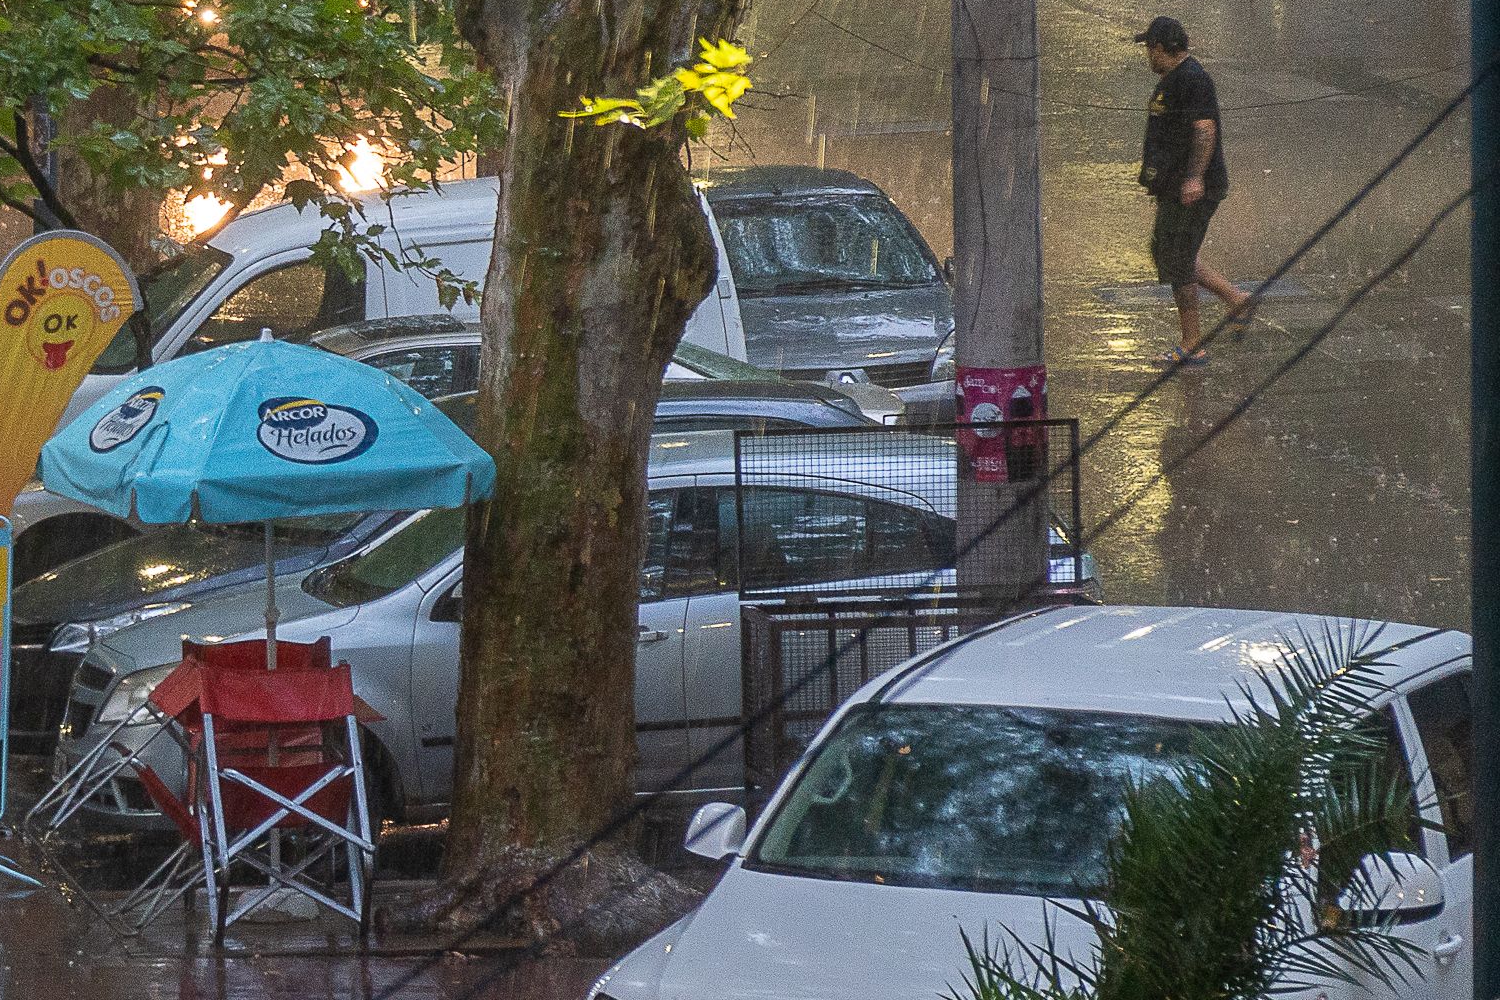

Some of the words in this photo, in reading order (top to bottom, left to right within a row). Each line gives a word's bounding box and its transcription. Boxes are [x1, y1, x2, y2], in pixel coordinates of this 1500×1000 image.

[43, 313, 78, 333] OK
[263, 406, 325, 422] ARCOR
[270, 423, 357, 449] Helados
